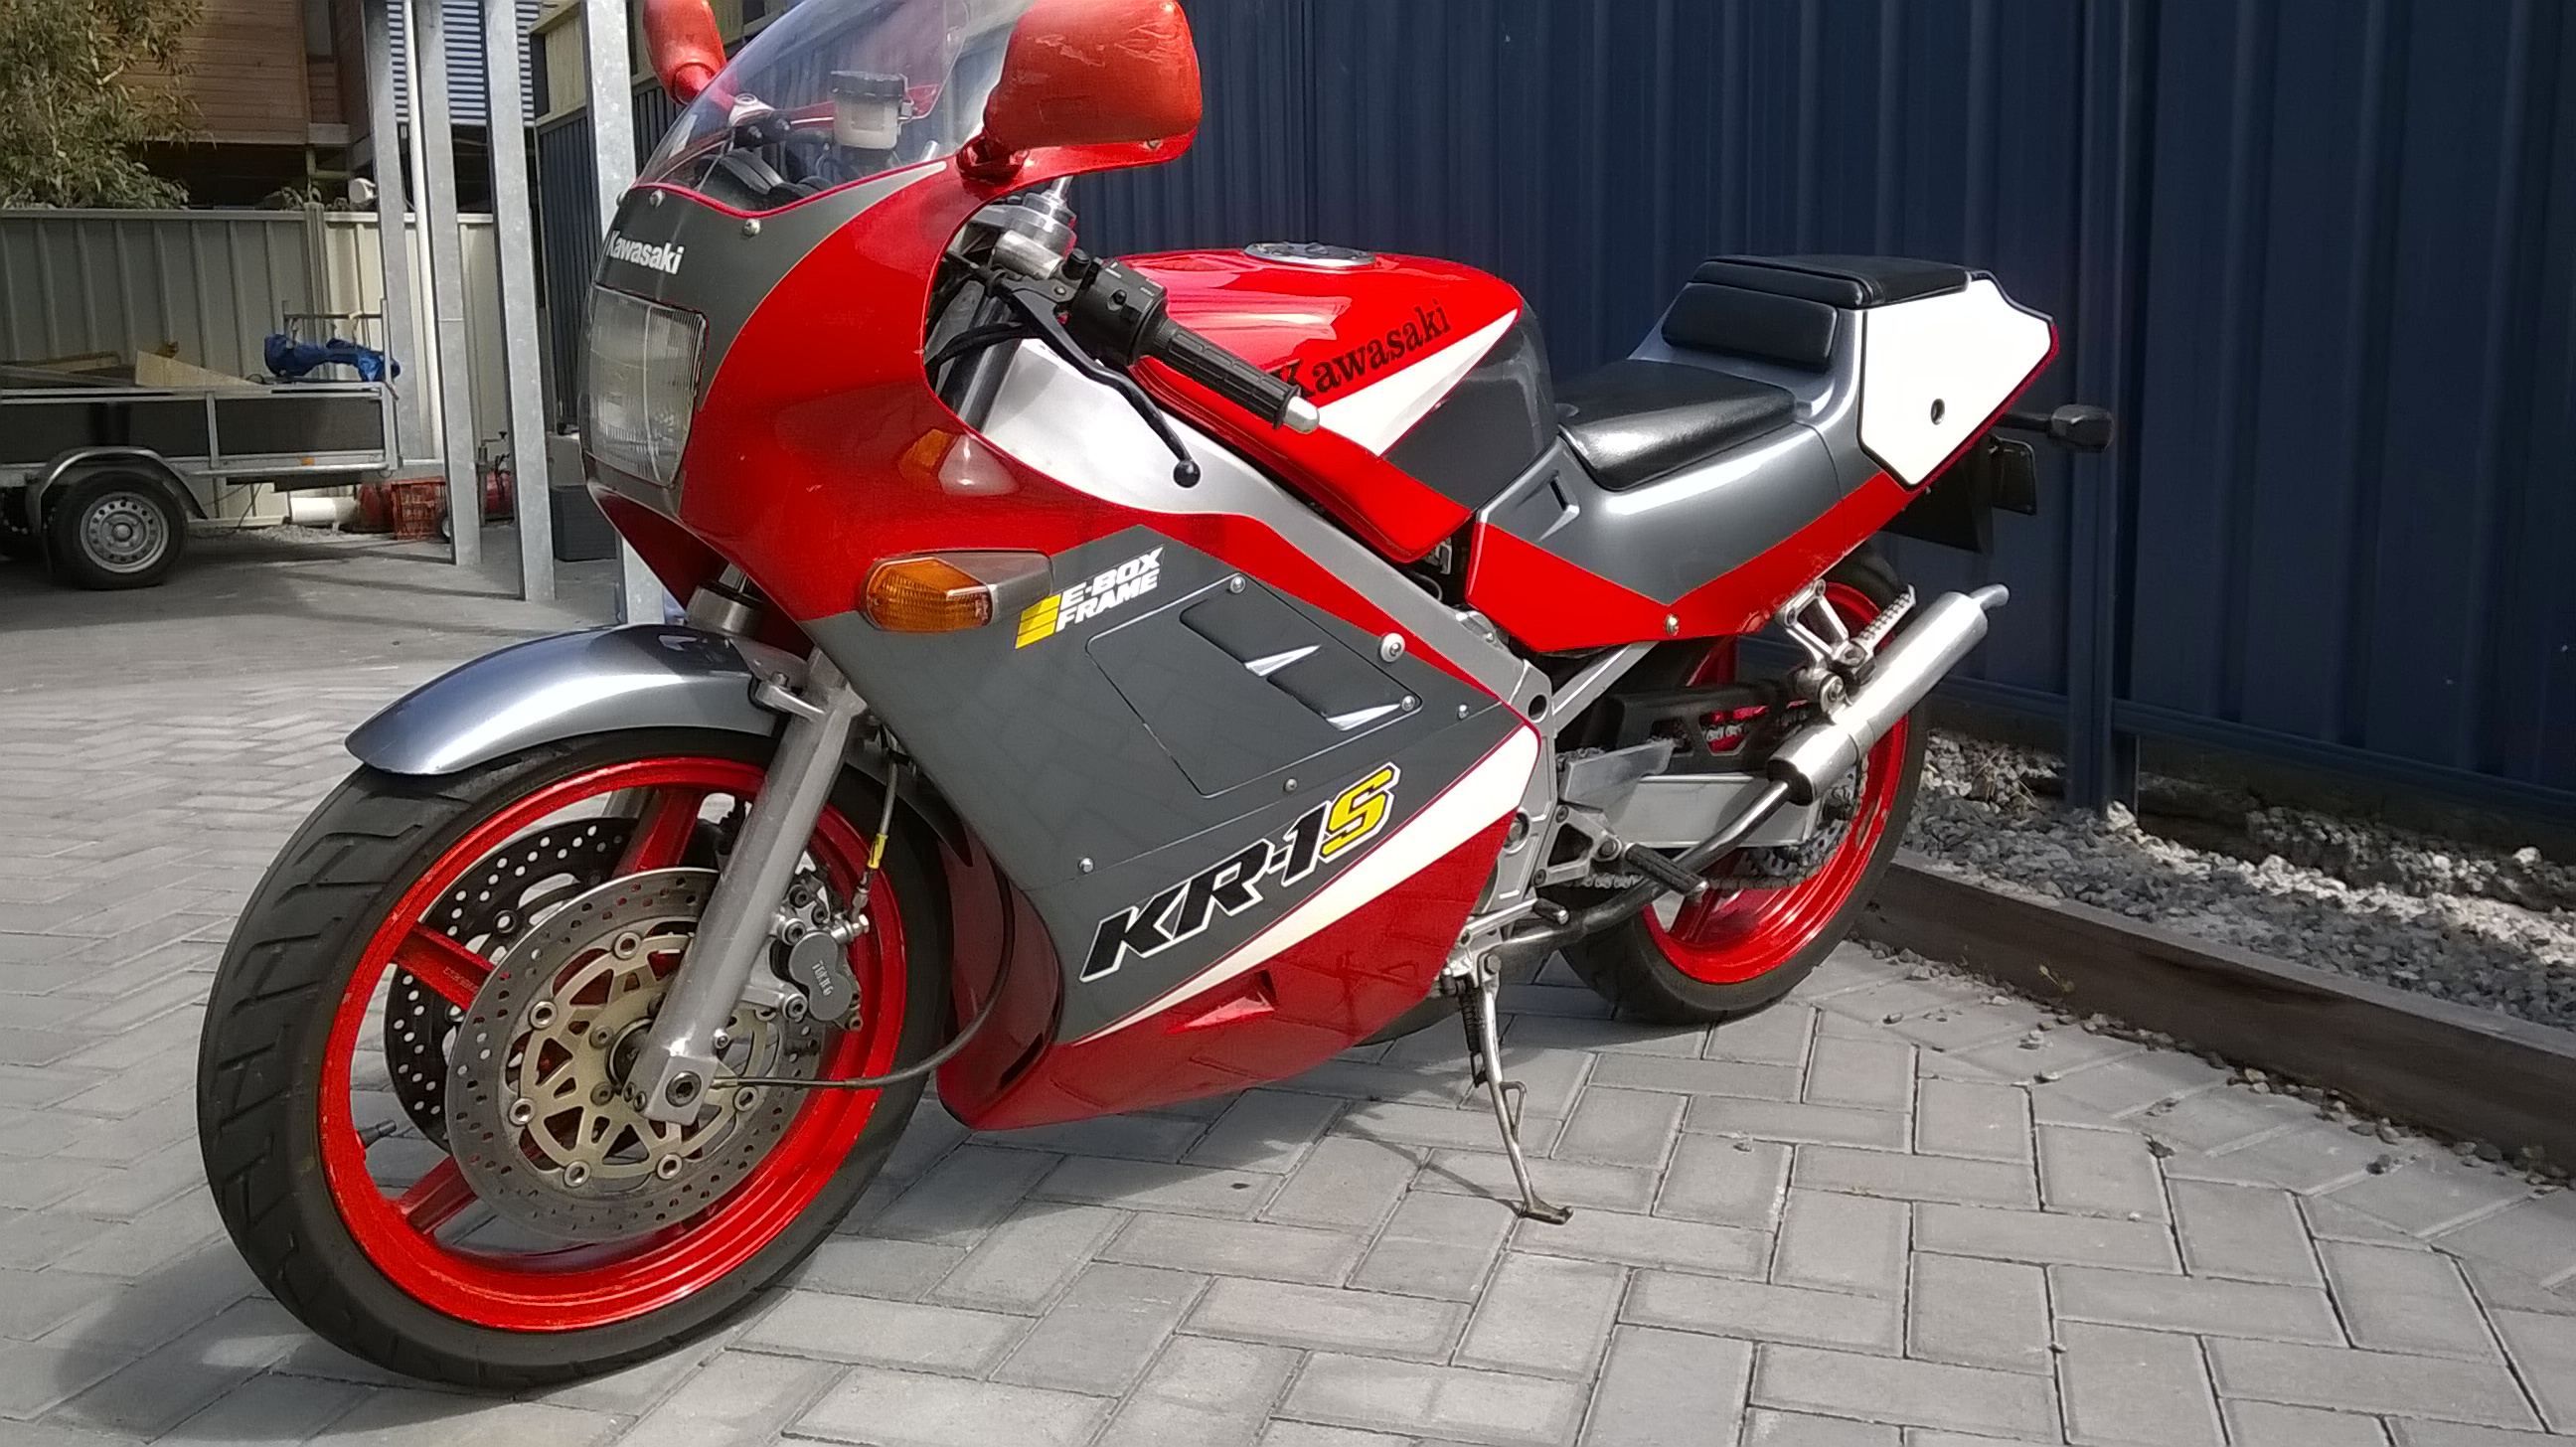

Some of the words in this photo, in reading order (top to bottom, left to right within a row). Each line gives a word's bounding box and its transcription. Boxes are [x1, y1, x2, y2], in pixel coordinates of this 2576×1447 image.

[606, 230, 685, 275] Kawasaki
[1055, 567, 1161, 633] FRAME
[1059, 547, 1164, 610] E-BOX
[1079, 761, 1401, 983] KR-1S
